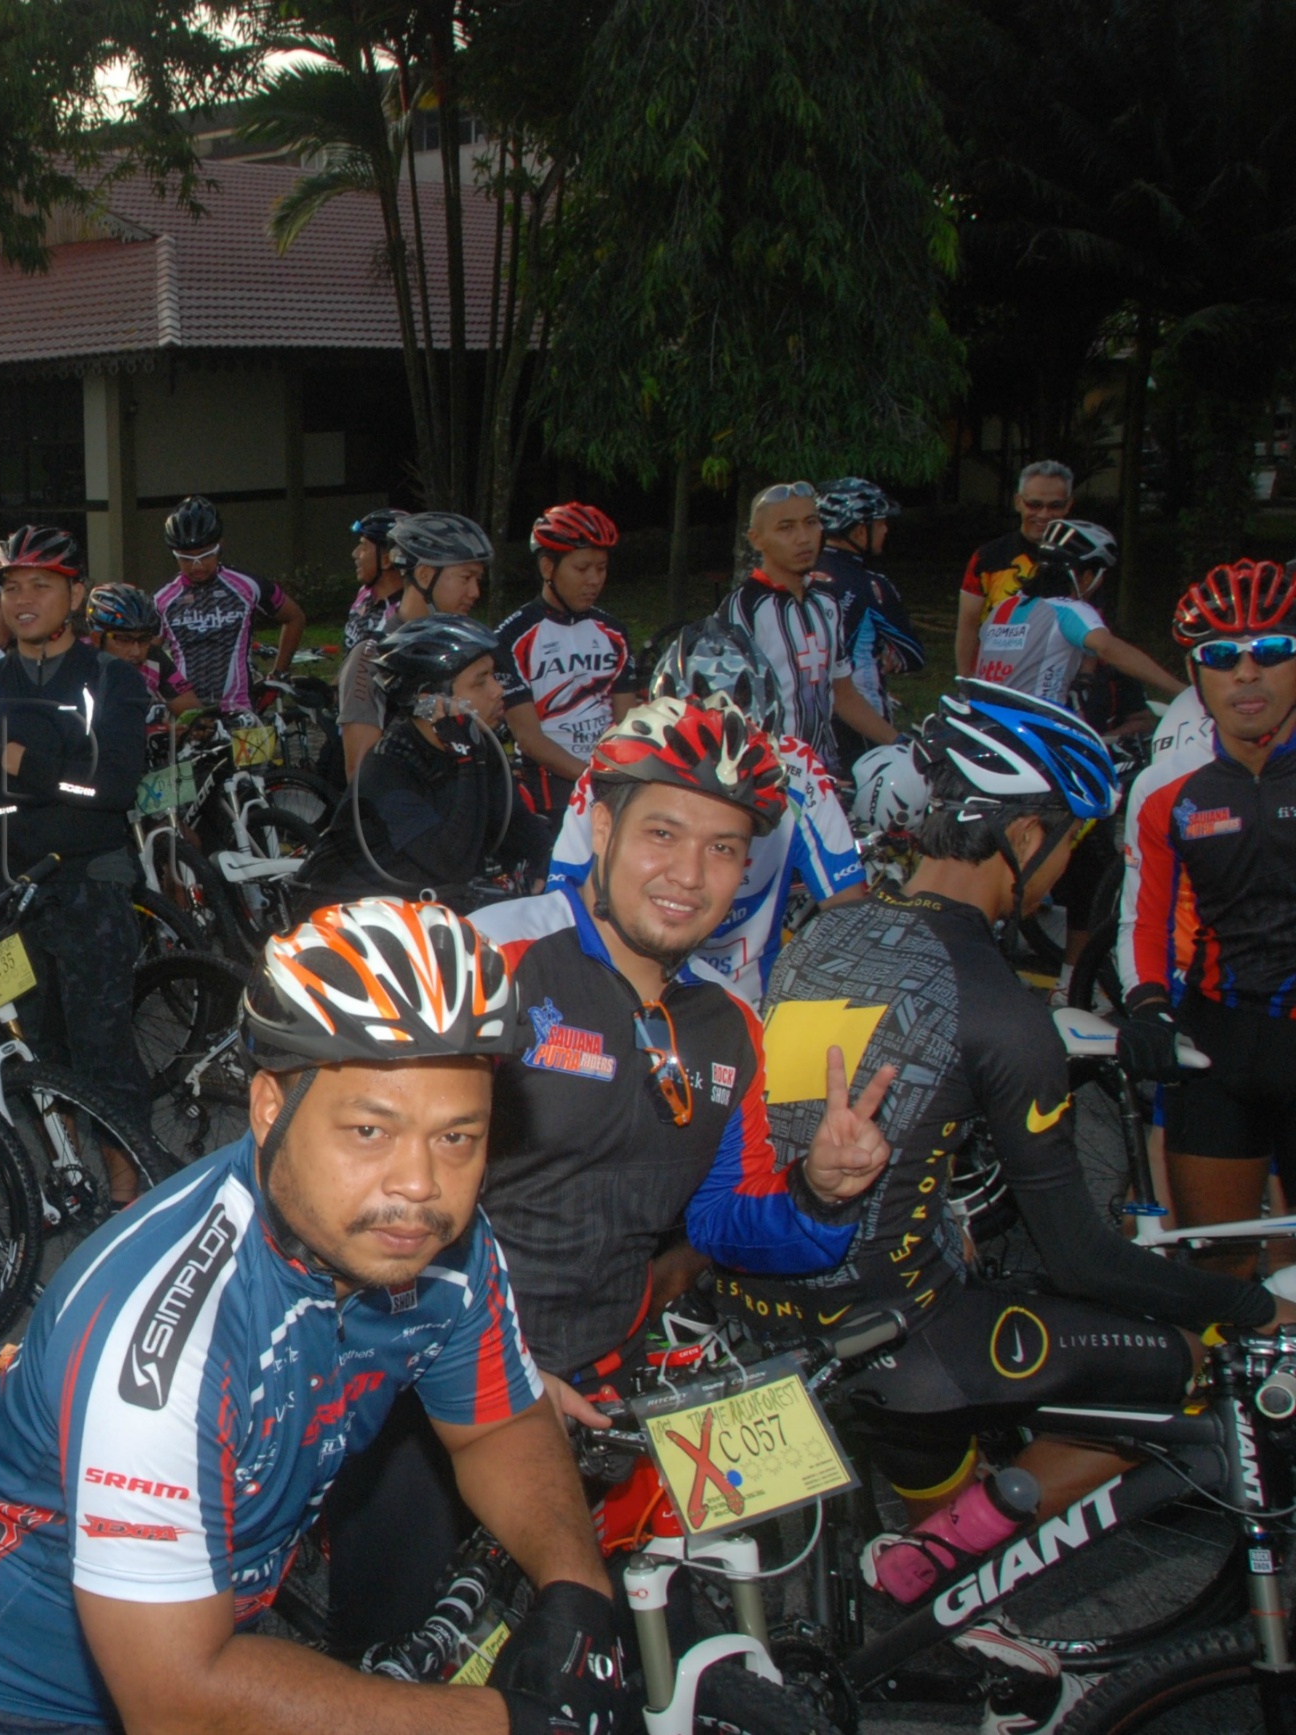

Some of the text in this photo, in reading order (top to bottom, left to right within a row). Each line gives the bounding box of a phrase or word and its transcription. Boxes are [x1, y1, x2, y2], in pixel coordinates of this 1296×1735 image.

[529, 652, 618, 681] JAMIS
[1042, 664, 1055, 698] MEGA
[547, 1025, 603, 1056] SAUJANA
[533, 1046, 615, 1075] PUTRA RIDERS
[712, 1063, 735, 1088] ROCK
[897, 1086, 925, 1131] STRONGER
[141, 1208, 232, 1359] SIMPLON
[1059, 1334, 1168, 1349] LIVESTRONG
[730, 1380, 801, 1428] RAINFOREST
[718, 1413, 788, 1464] C 057
[1232, 1399, 1265, 1507] GIANT
[84, 1467, 191, 1501] SRAM
[82, 1514, 182, 1543] TEXPA
[932, 1473, 1124, 1627] GIANT
